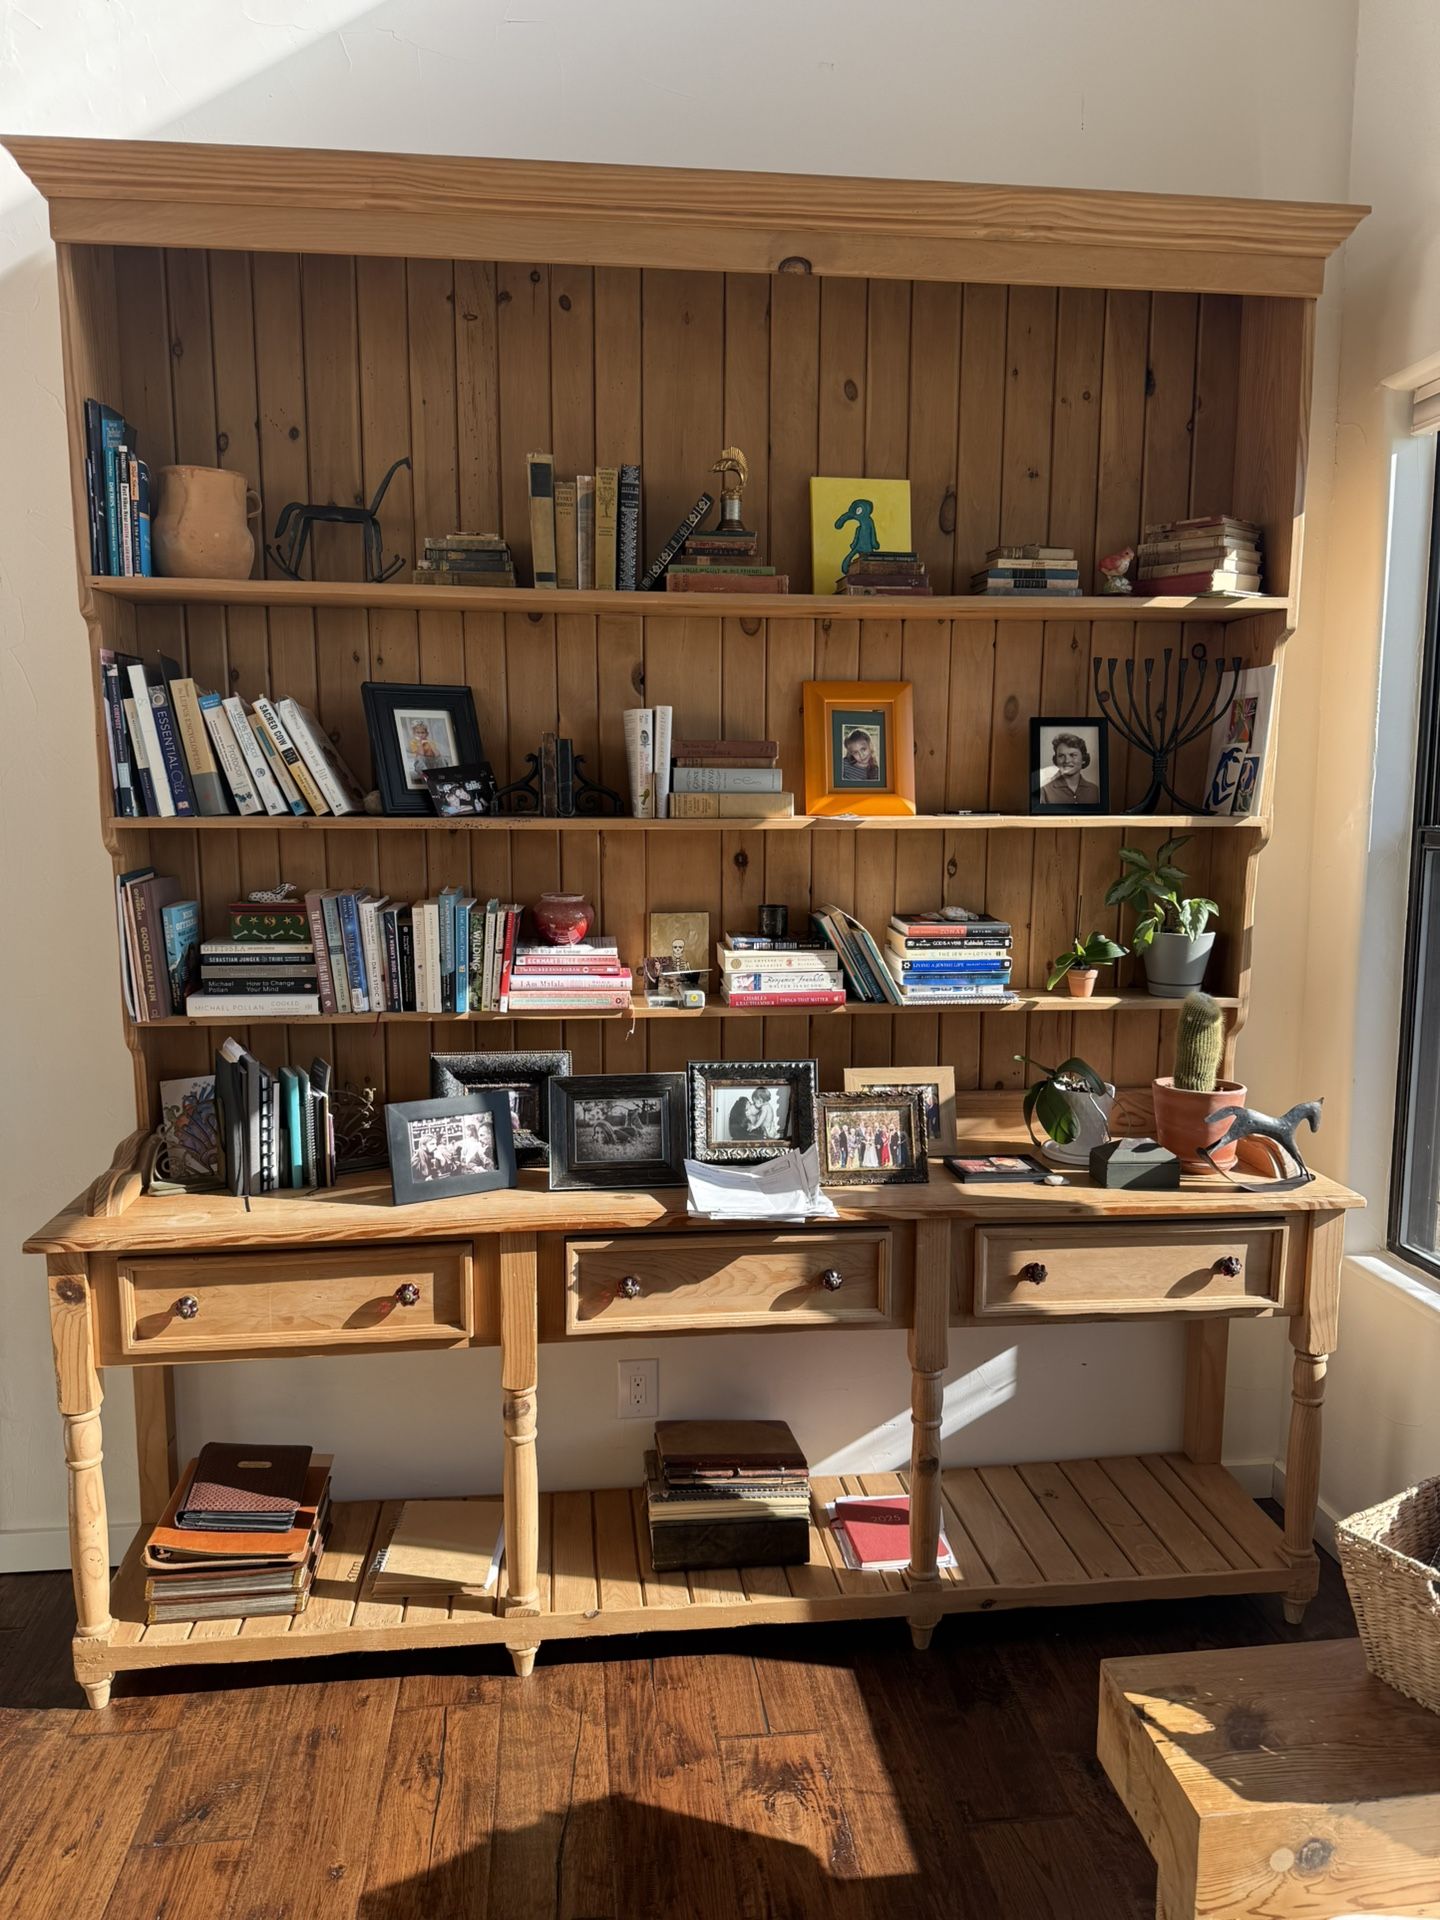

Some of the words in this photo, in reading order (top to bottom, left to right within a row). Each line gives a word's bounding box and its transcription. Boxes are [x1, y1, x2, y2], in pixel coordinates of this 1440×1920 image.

[113, 704, 121, 729] COMPOST
[259, 704, 277, 730] SACRED
[273, 731, 287, 746] COW
[179, 695, 189, 718] LUPUS
[185, 718, 202, 770] ENCYCLOPEDIA
[157, 711, 178, 769] ESSENTIAL
[171, 770, 185, 794] Oils
[244, 733, 259, 759] Protocol
[227, 744, 244, 778] Protocol
[133, 888, 142, 920] OFFERMAN
[311, 911, 320, 920] THE
[140, 927, 150, 952] GOOD
[312, 920, 322, 939] TIBETAN
[315, 940, 323, 950] BOOK
[472, 931, 481, 971] WILDING
[144, 954, 154, 982] CLEAN
[318, 958, 327, 971] LIVING
[320, 972, 329, 981] AND
[764, 976, 795, 984] Benjamin
[799, 974, 824, 982] Franklin
[147, 984, 157, 1001] FUN
[321, 982, 331, 995] DYING
[194, 1004, 230, 1012] MICHAEL
[870, 1513, 901, 1522] 2025
